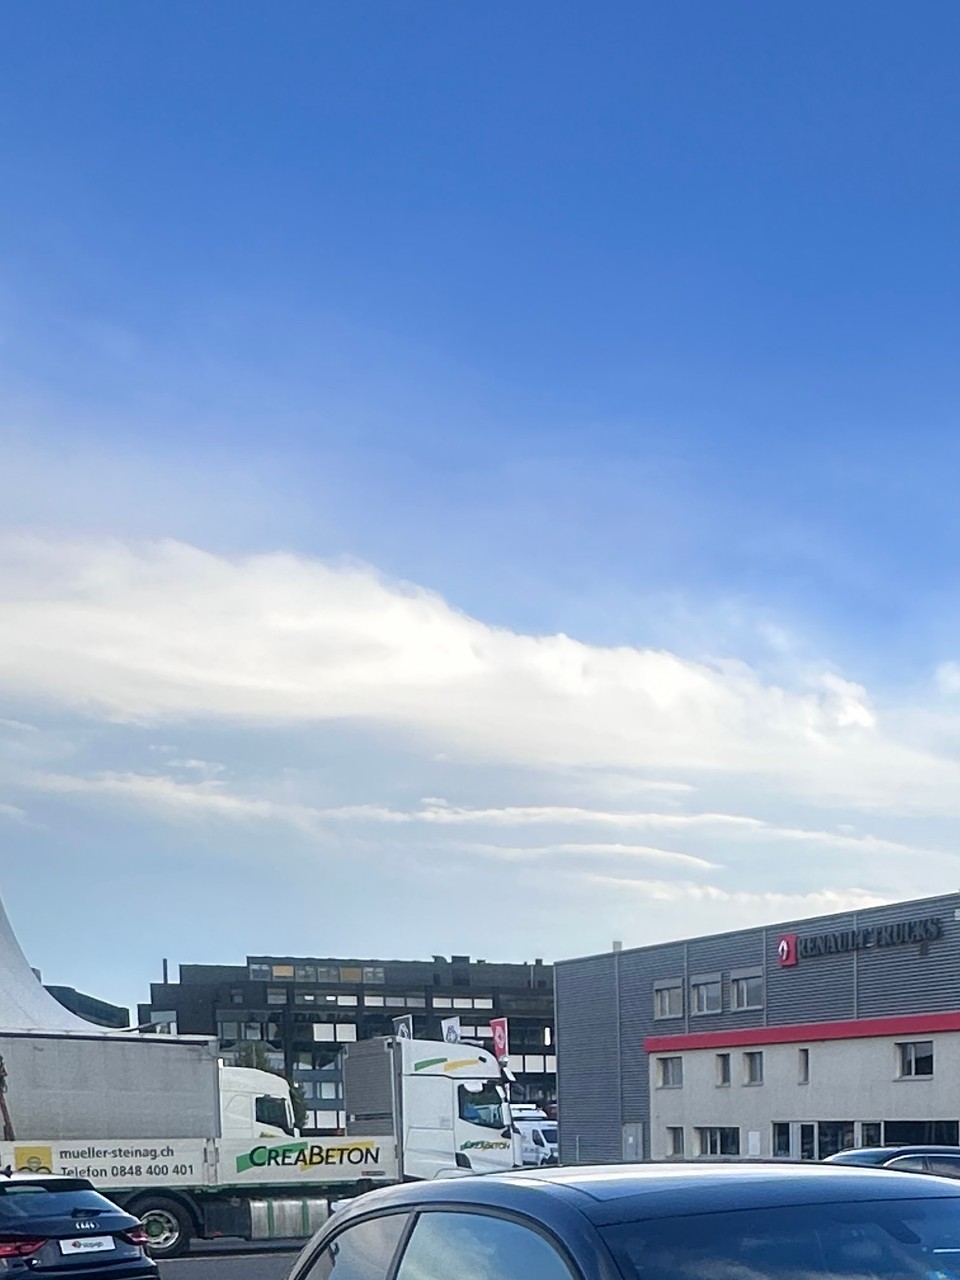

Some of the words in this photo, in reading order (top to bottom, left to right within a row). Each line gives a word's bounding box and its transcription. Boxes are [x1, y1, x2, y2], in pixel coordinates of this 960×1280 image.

[798, 929, 875, 958] RENAULT
[873, 918, 943, 946] TRUCKS
[59, 1146, 174, 1161] mueller-steinag.ch
[60, 1165, 107, 1178] Telefon
[111, 1164, 143, 1177] 0848
[146, 1164, 169, 1176] 400
[172, 1163, 194, 1176] 401
